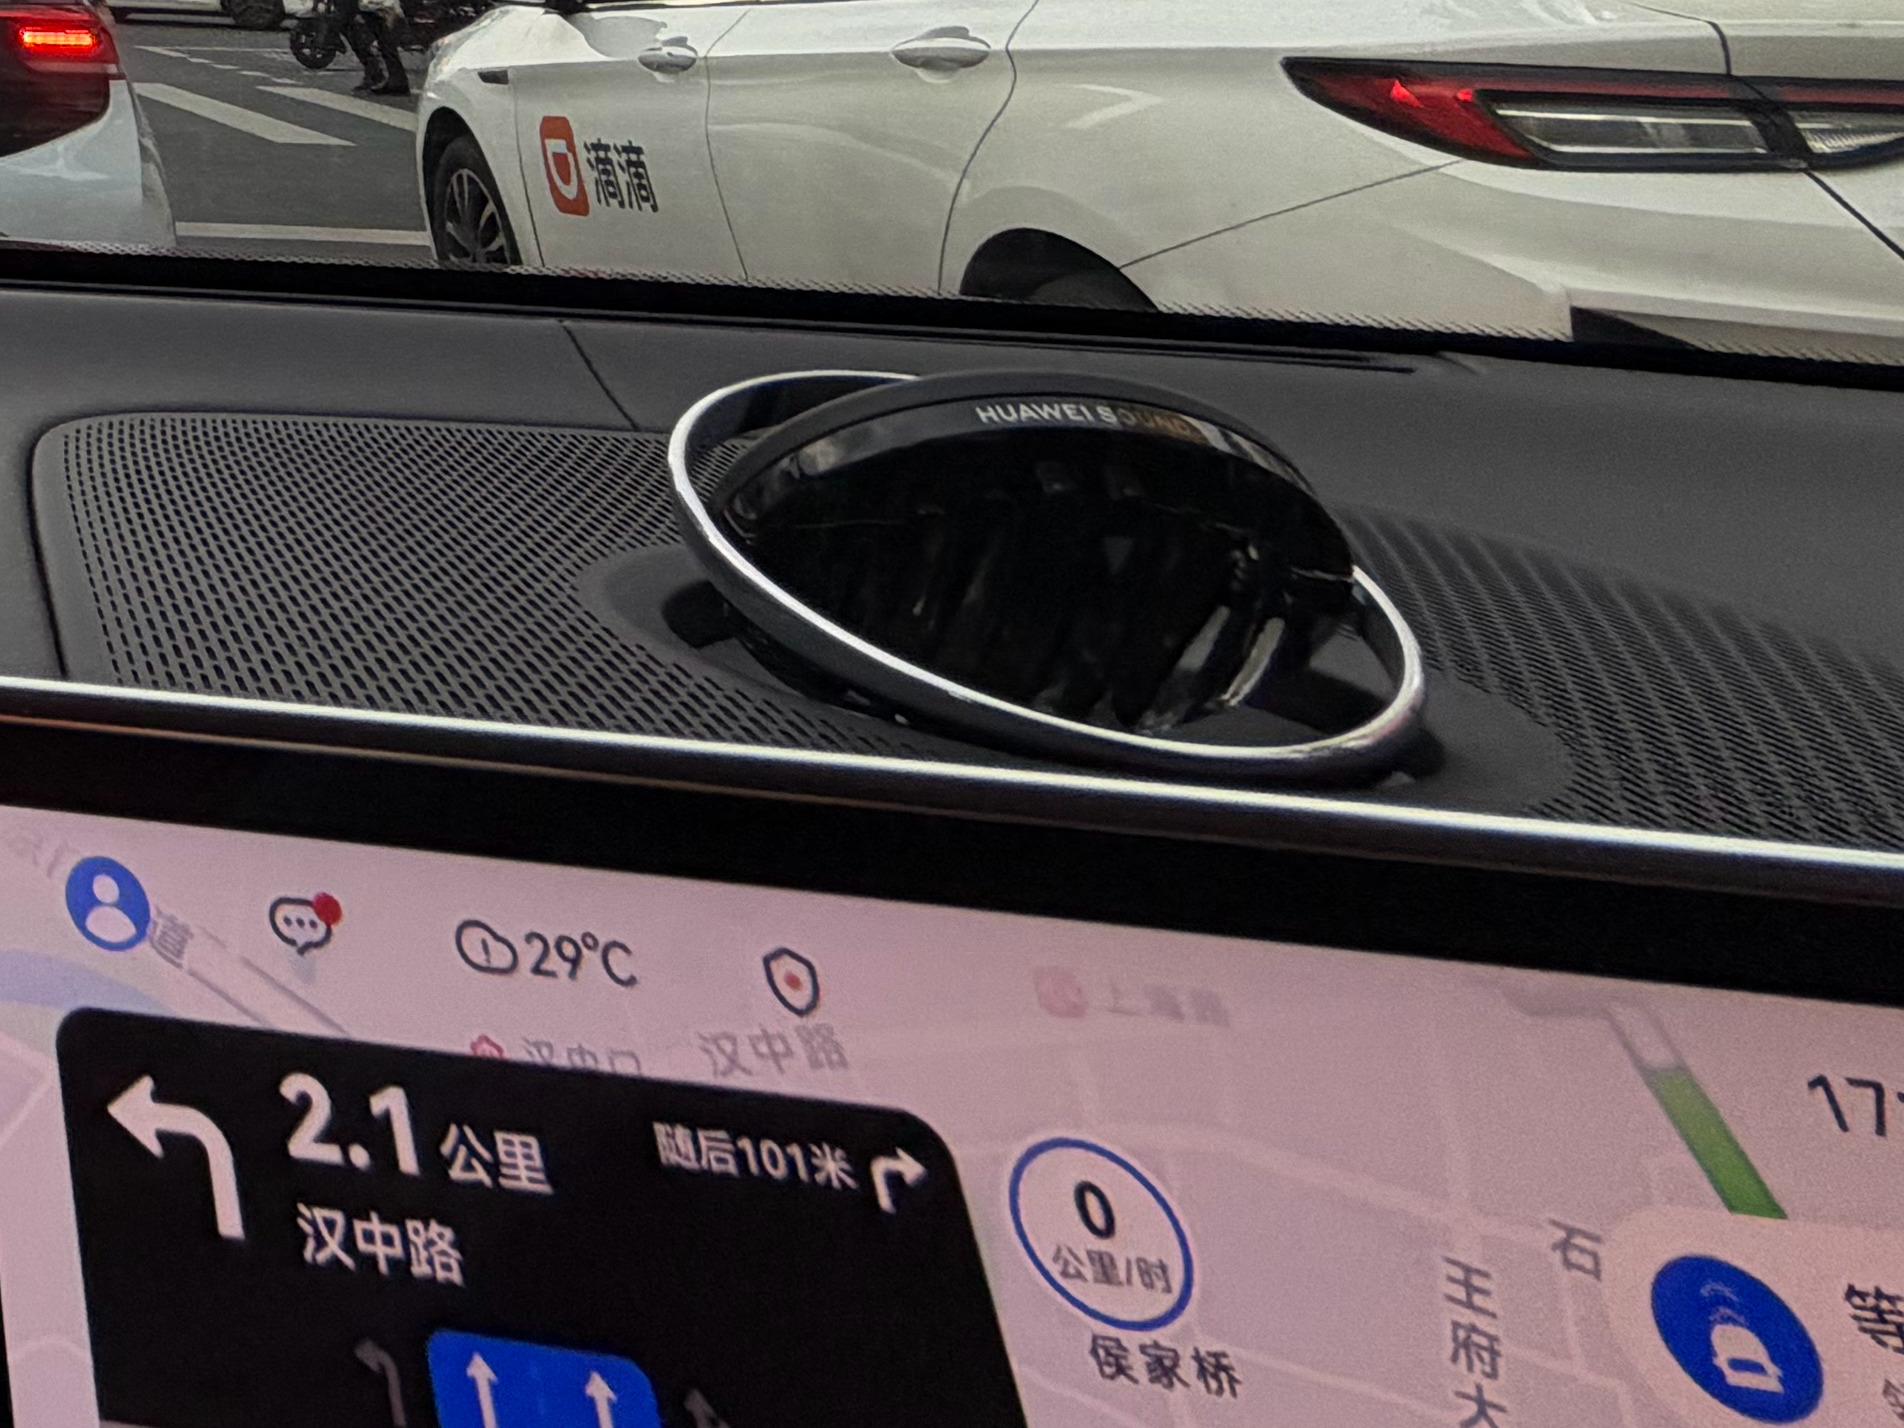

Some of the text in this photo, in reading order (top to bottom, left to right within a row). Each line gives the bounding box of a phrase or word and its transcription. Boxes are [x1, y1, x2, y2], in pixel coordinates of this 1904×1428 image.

[583, 138, 660, 214] 滴滴
[975, 402, 1093, 425] HUAWEI
[523, 930, 638, 988] 29°C
[696, 1023, 850, 1077] 汉中路
[278, 1072, 554, 1194] 2.1 公里
[653, 1121, 861, 1190] 随后101米
[1073, 1178, 1116, 1240] 0
[296, 1201, 467, 1289] 汉中路
[1052, 1243, 1173, 1294] 公里/时
[1089, 1332, 1244, 1399] 侯家桥
